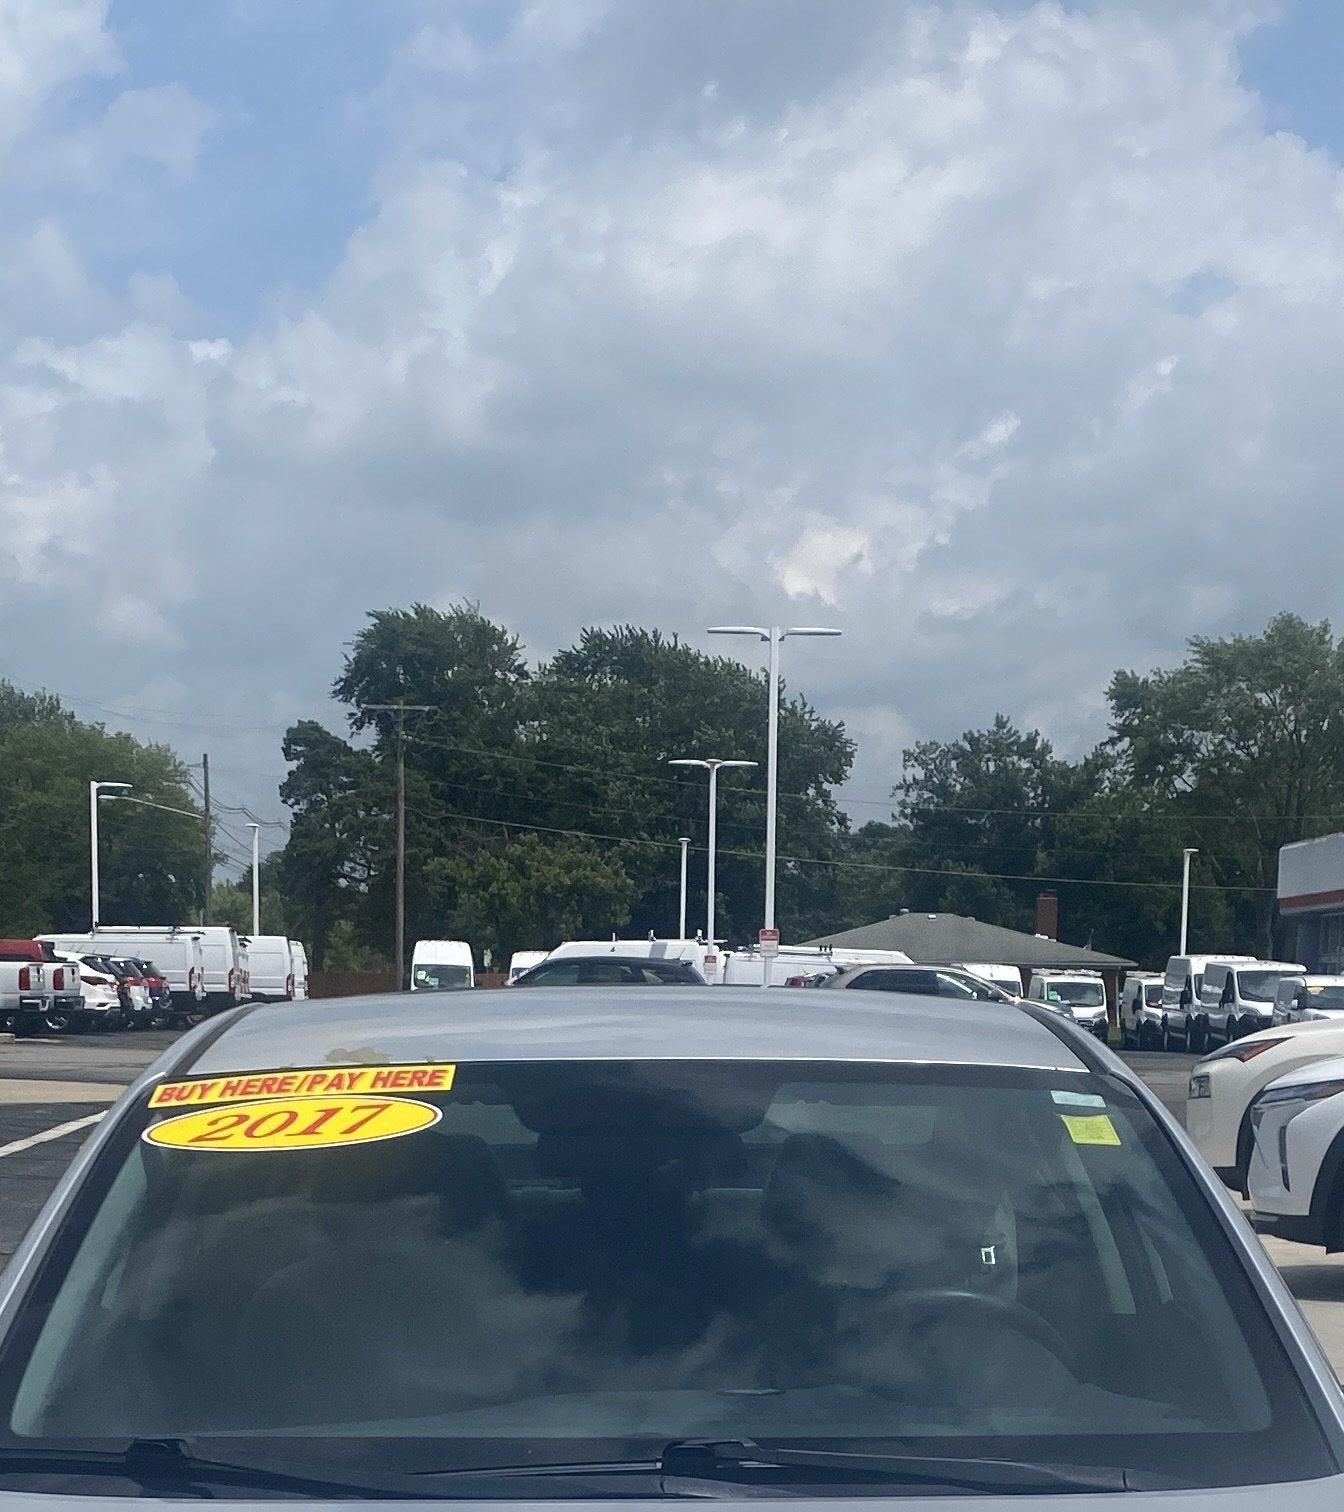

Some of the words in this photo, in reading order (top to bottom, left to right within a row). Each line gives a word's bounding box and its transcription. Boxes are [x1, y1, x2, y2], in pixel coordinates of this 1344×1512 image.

[155, 1082, 218, 1103] BUY
[219, 1072, 367, 1098] HERE/PAY
[370, 1070, 448, 1088] HERE
[188, 1104, 393, 1142] 2017
